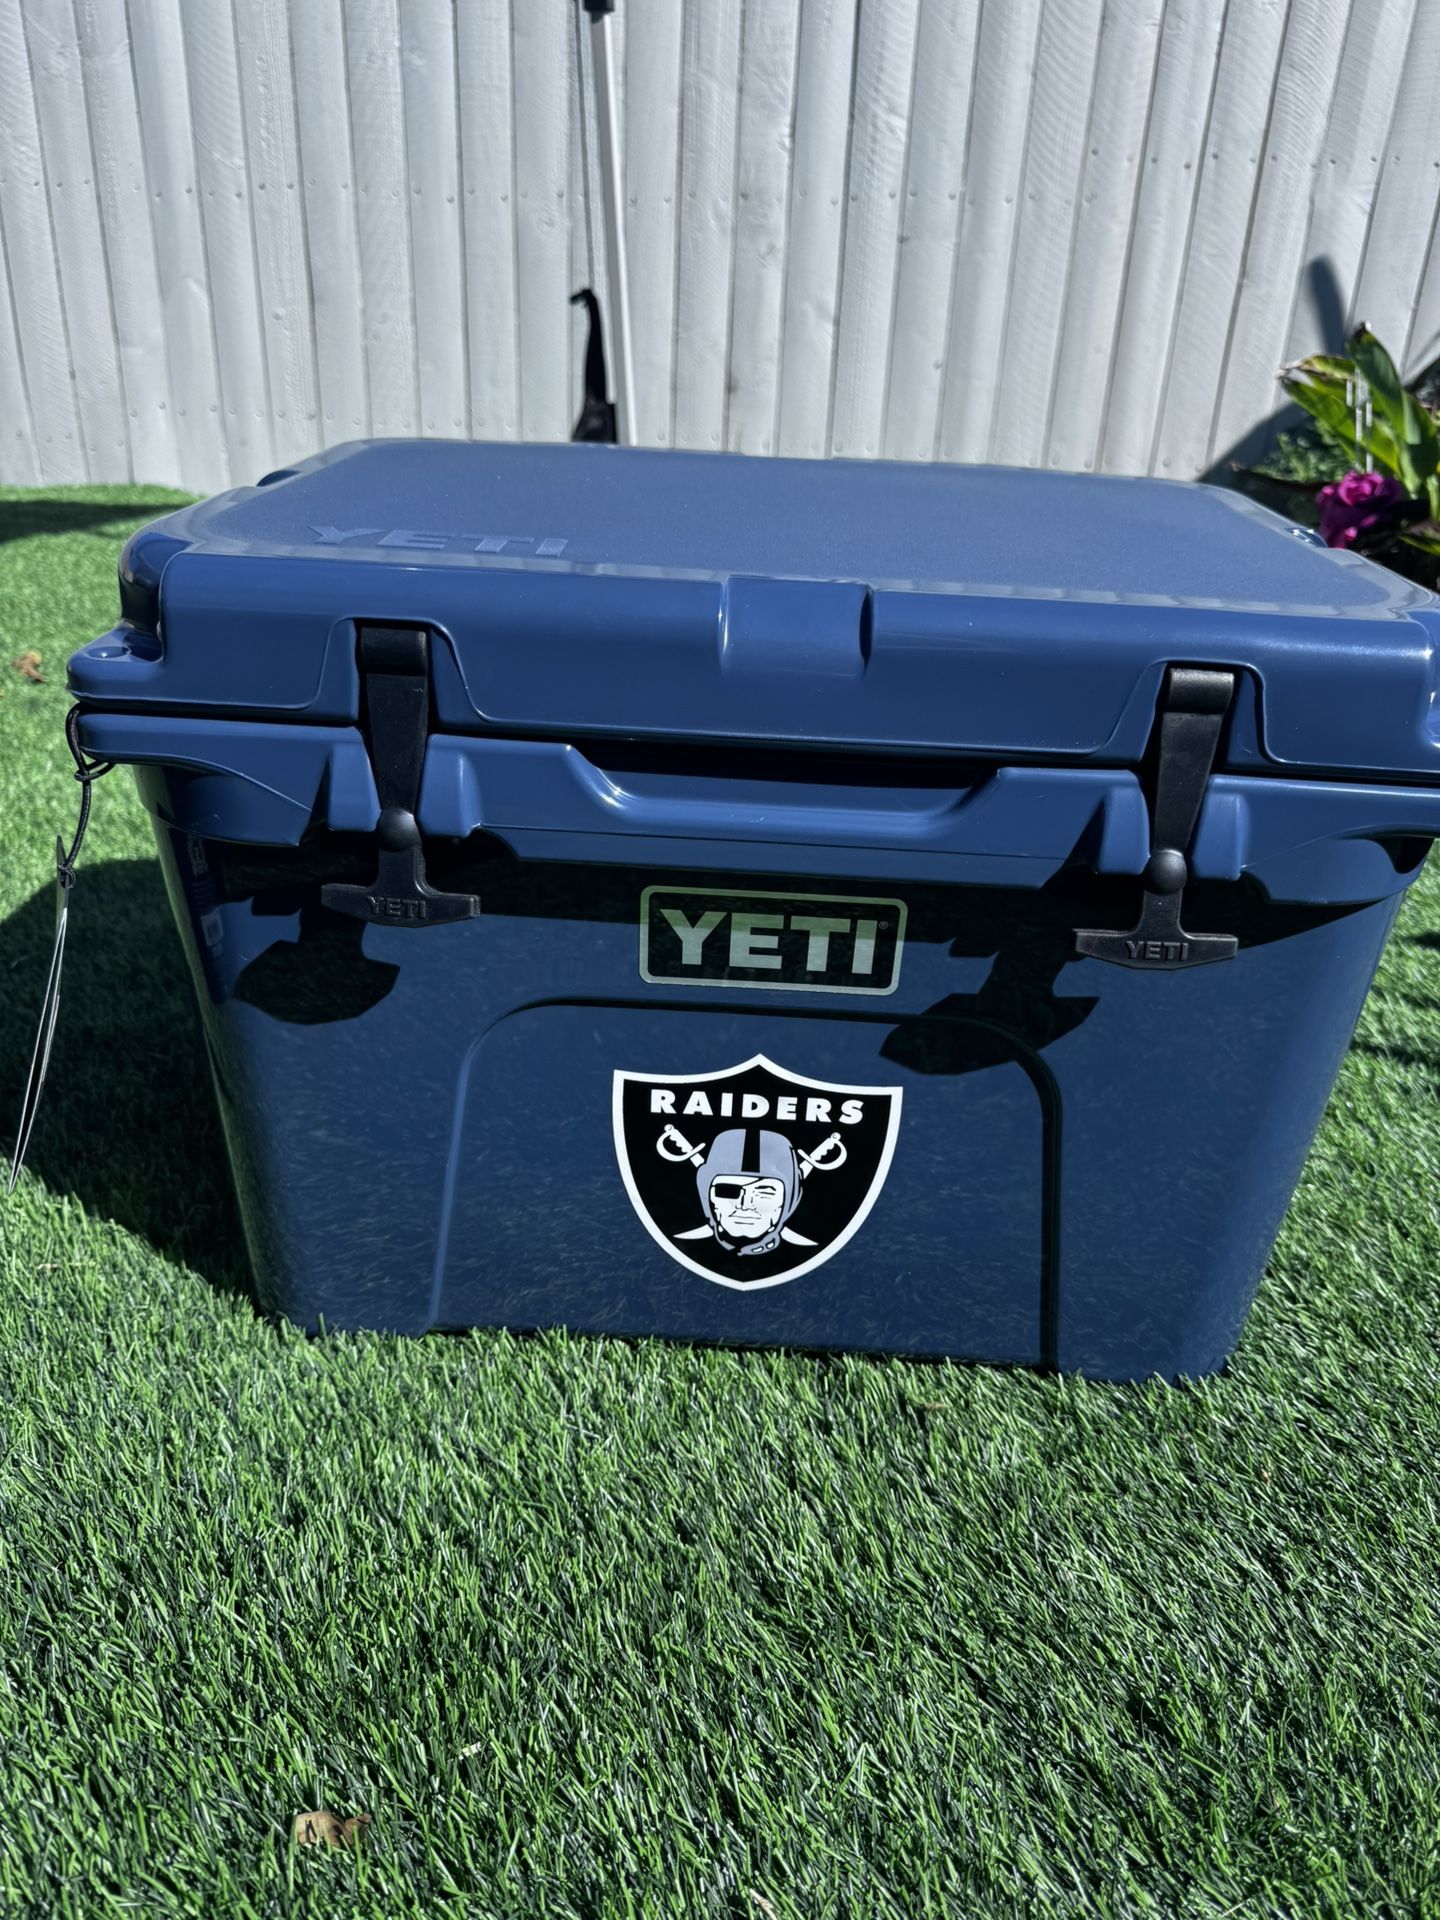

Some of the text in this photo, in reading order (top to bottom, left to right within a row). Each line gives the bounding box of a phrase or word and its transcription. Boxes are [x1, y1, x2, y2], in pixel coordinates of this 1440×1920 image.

[308, 525, 568, 557] YETI
[367, 895, 429, 919] YETI
[1126, 939, 1190, 961] YETI
[650, 1088, 864, 1125] RAIDERS
